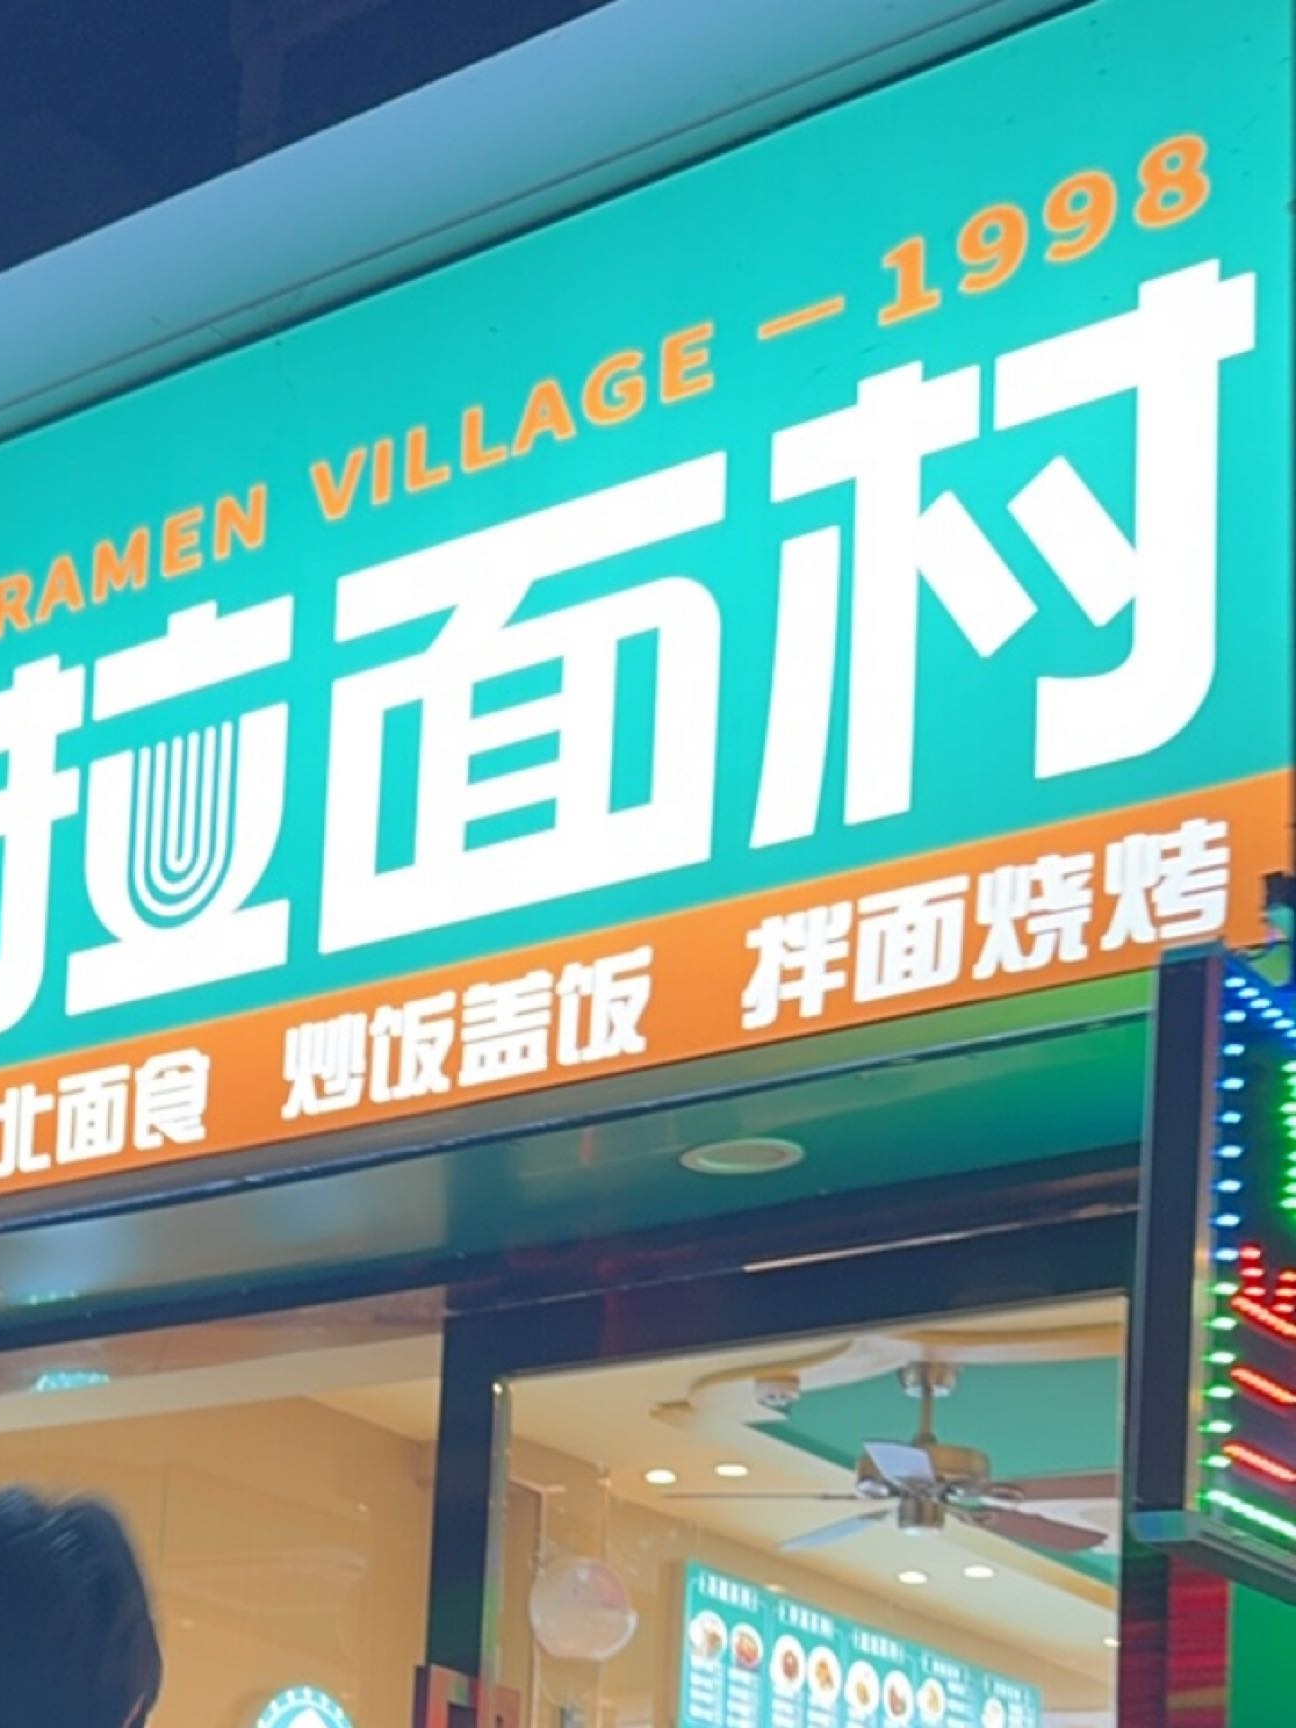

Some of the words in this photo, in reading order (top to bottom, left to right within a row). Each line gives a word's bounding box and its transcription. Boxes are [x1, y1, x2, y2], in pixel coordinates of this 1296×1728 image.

[310, 321, 714, 521] VILLAGE
[876, 133, 1211, 326] 1998
[280, 945, 653, 1120] 炒饭盖饭
[741, 817, 1230, 1030] 拌面烧烤
